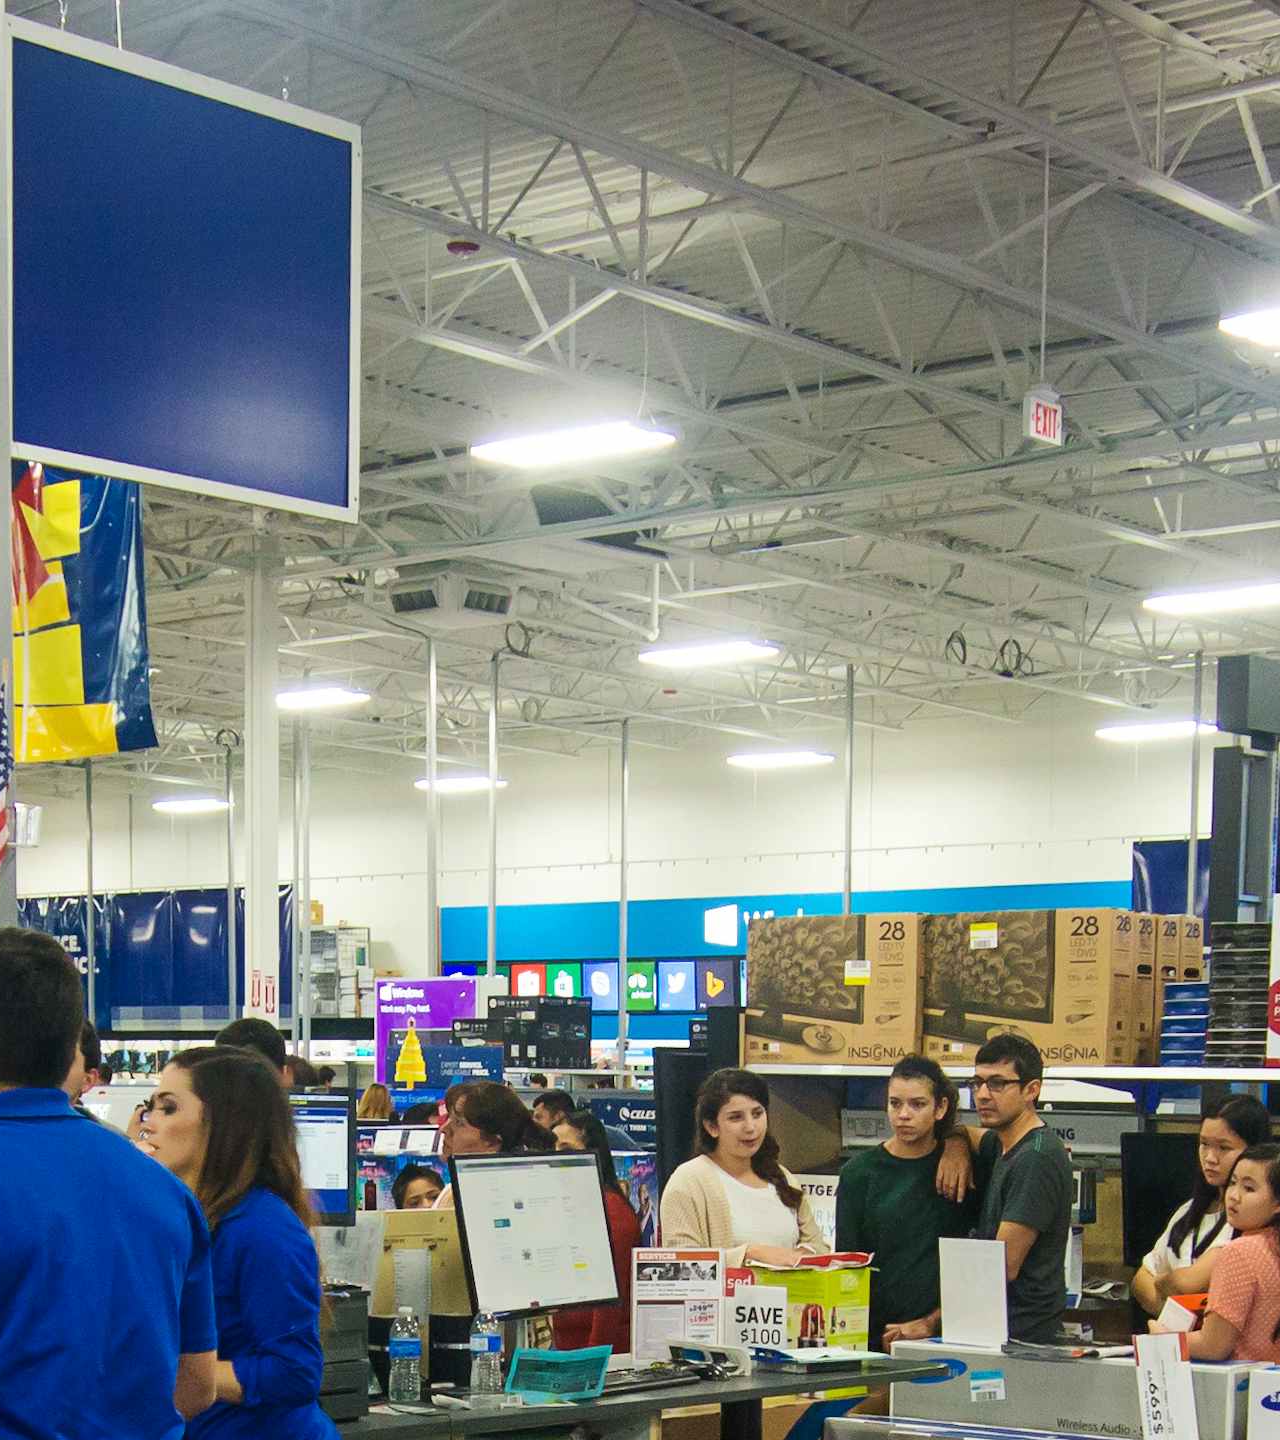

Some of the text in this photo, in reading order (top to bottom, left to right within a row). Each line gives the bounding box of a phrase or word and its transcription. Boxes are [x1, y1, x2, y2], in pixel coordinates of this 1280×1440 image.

[879, 921, 905, 940] 28
[1071, 916, 1099, 936] 28
[1116, 915, 1132, 932] 28
[1139, 918, 1153, 935] 28
[1162, 920, 1177, 937] 28
[1185, 923, 1200, 939] 28
[848, 1047, 906, 1061] INSIGNIA
[735, 1306, 783, 1325] SAVE
[740, 1329, 781, 1344] $100
[1057, 1418, 1131, 1436] Wireless Audio
